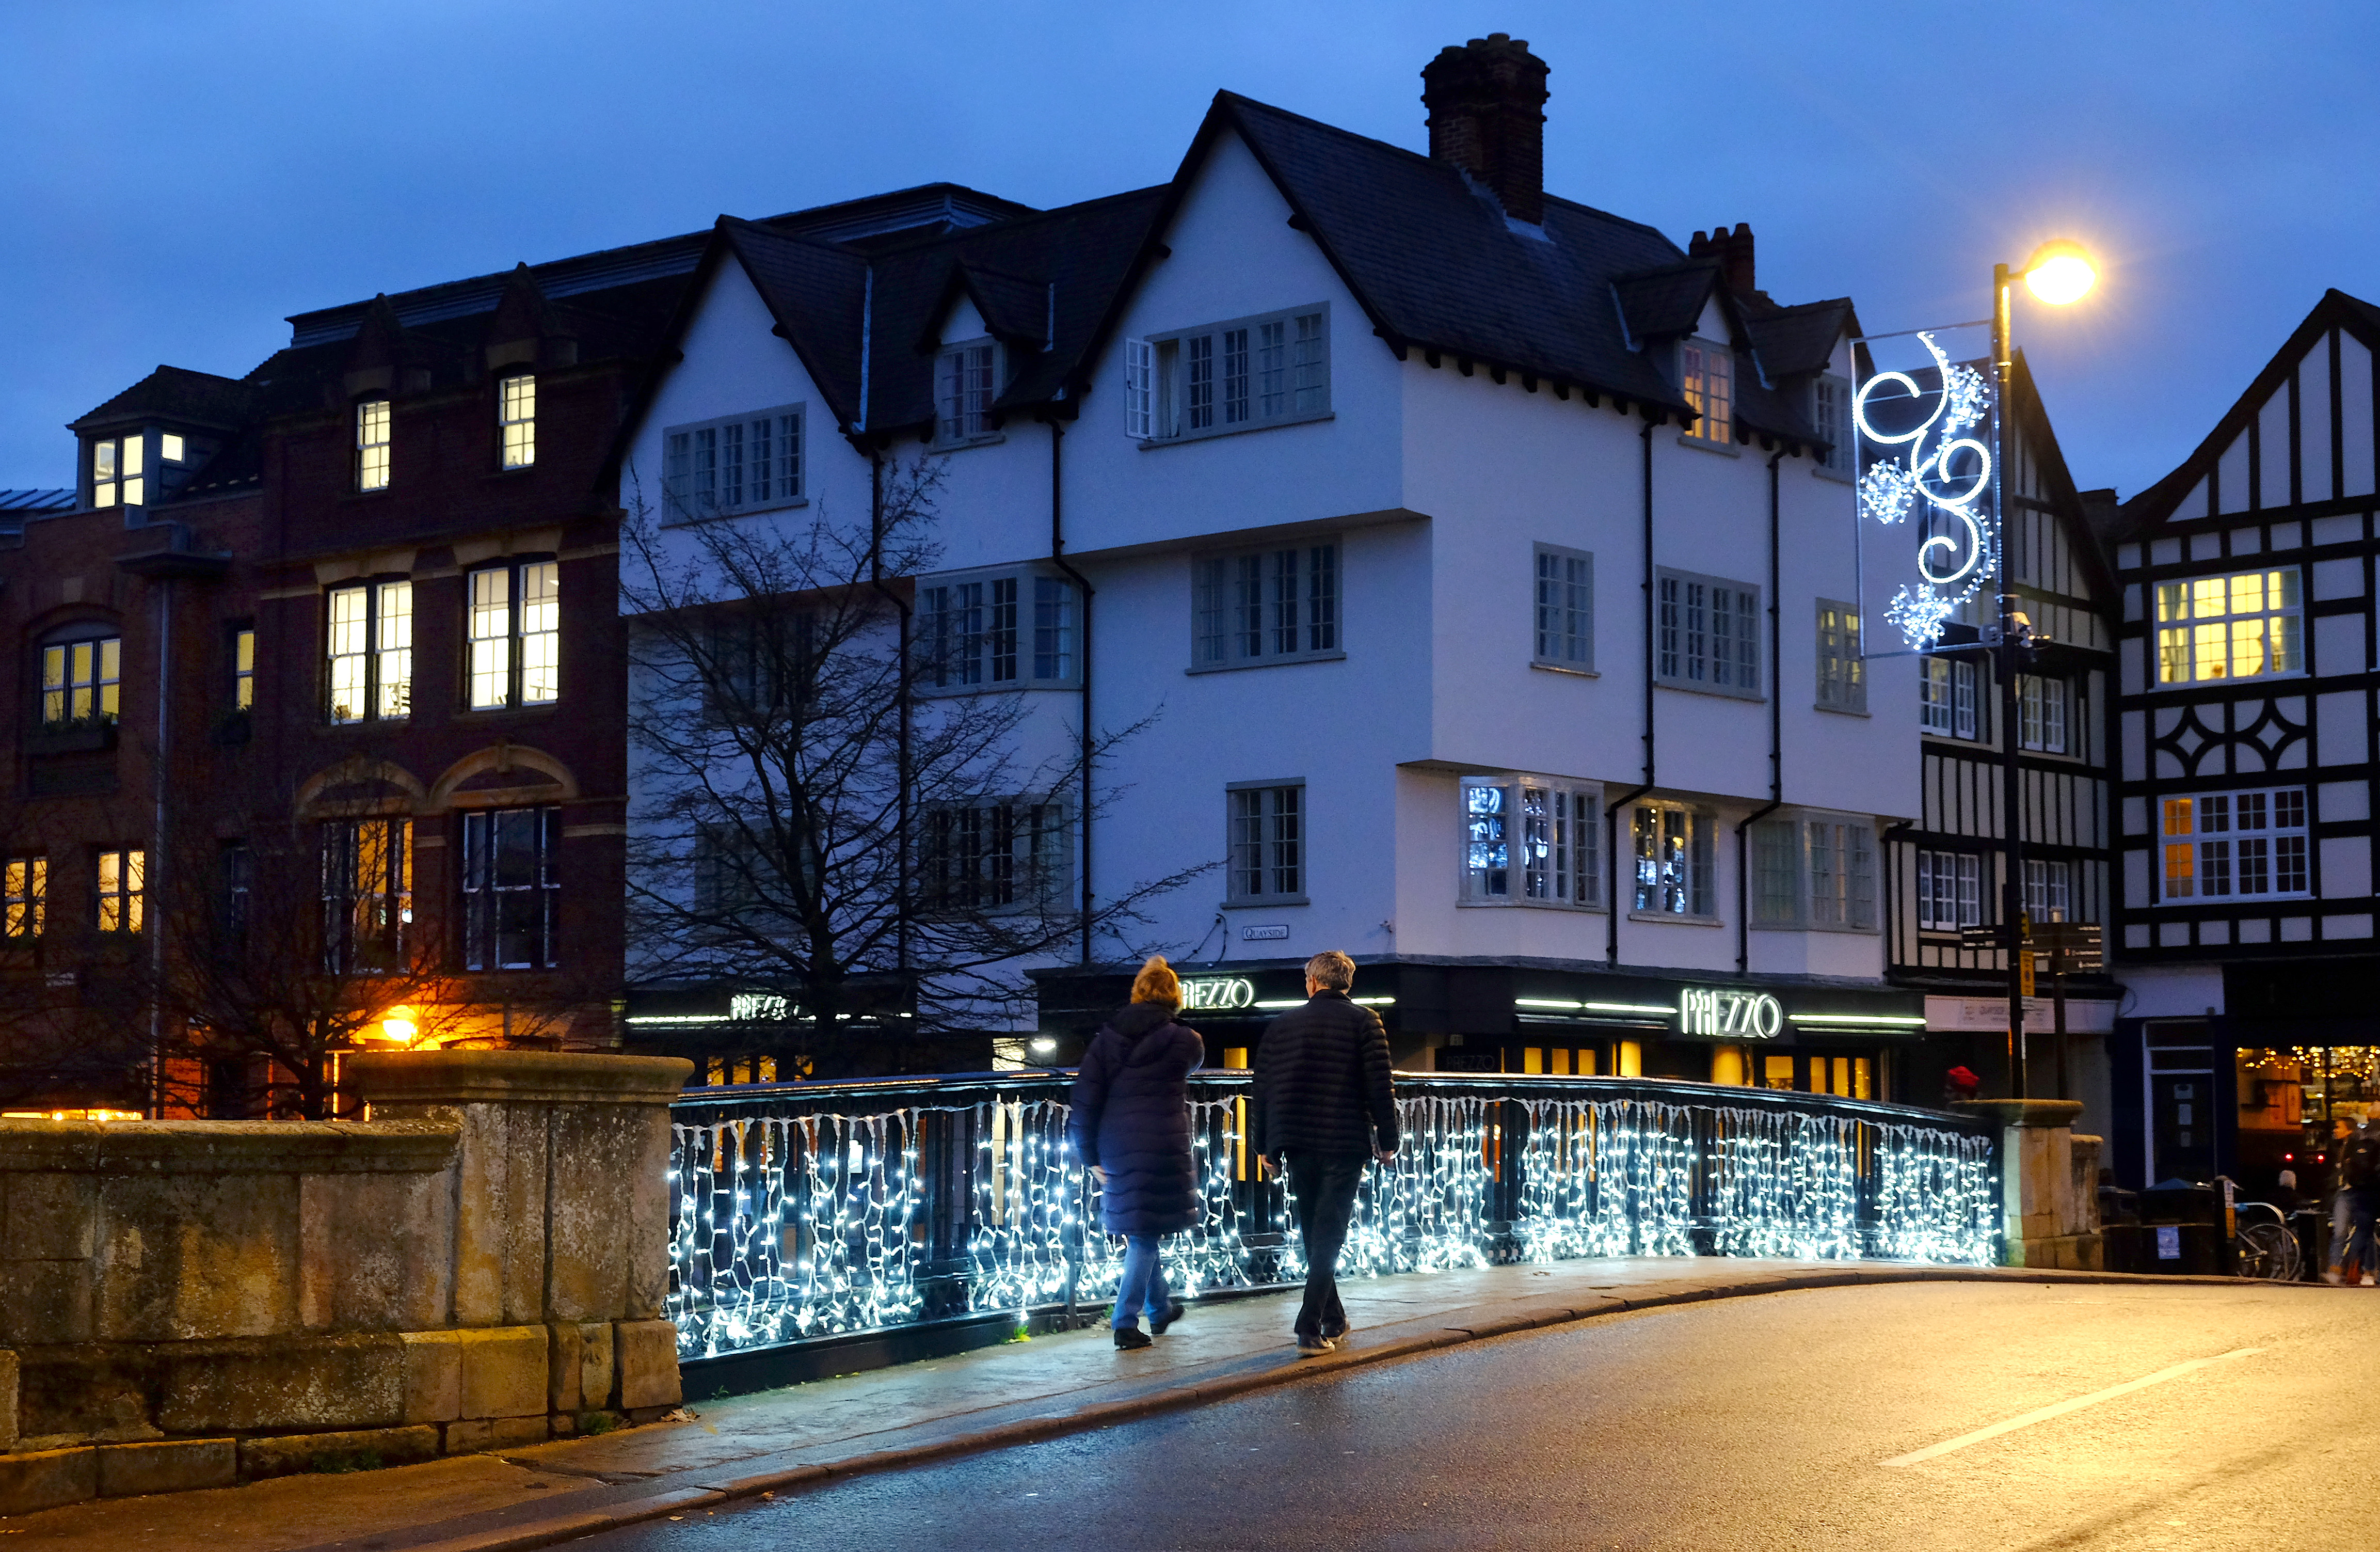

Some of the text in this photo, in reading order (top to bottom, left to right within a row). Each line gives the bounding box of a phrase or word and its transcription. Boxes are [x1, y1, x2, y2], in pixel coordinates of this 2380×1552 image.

[1245, 927, 1286, 938] QUAYSIDE
[1177, 978, 1254, 1009] REZZO
[1682, 988, 1783, 1039] PREZZO
